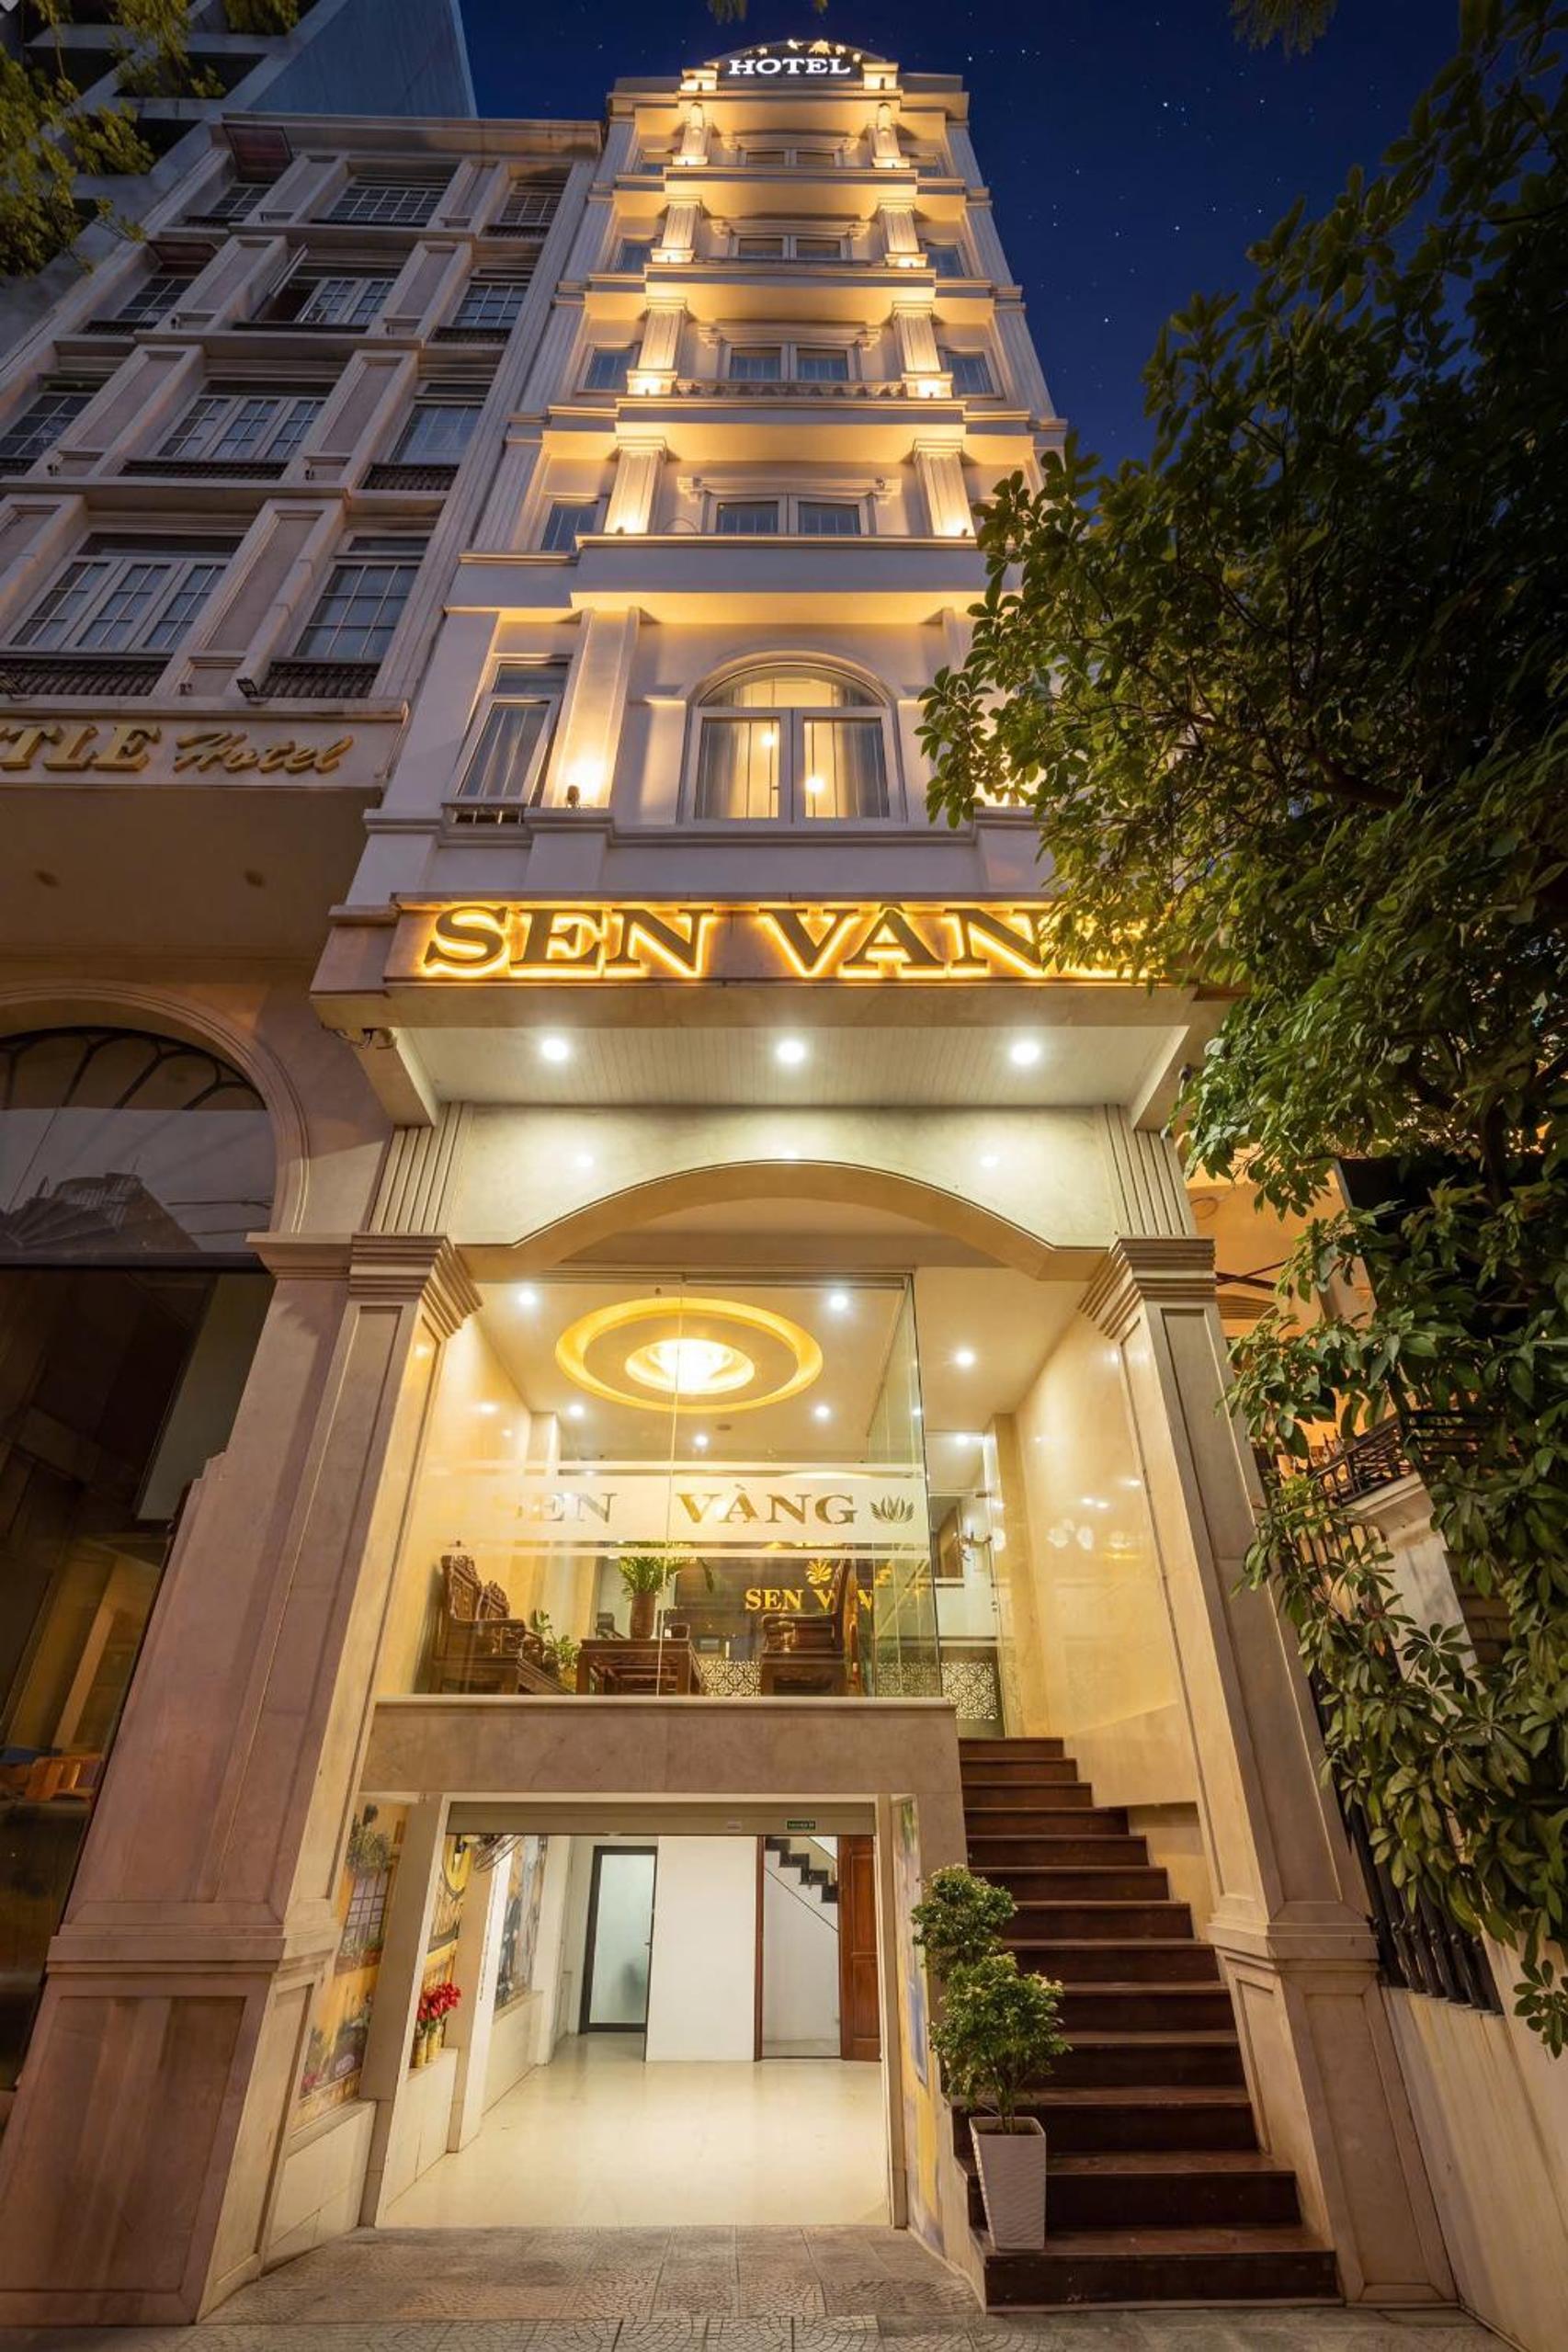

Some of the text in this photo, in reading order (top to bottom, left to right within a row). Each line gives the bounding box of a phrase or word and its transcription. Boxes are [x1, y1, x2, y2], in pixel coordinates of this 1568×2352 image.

[729, 58, 851, 74] HOTEL
[173, 732, 354, 774] Hotel
[423, 904, 714, 971] SEN
[492, 1483, 858, 1525] EN VÀNG
[744, 1587, 804, 1611] SEN
